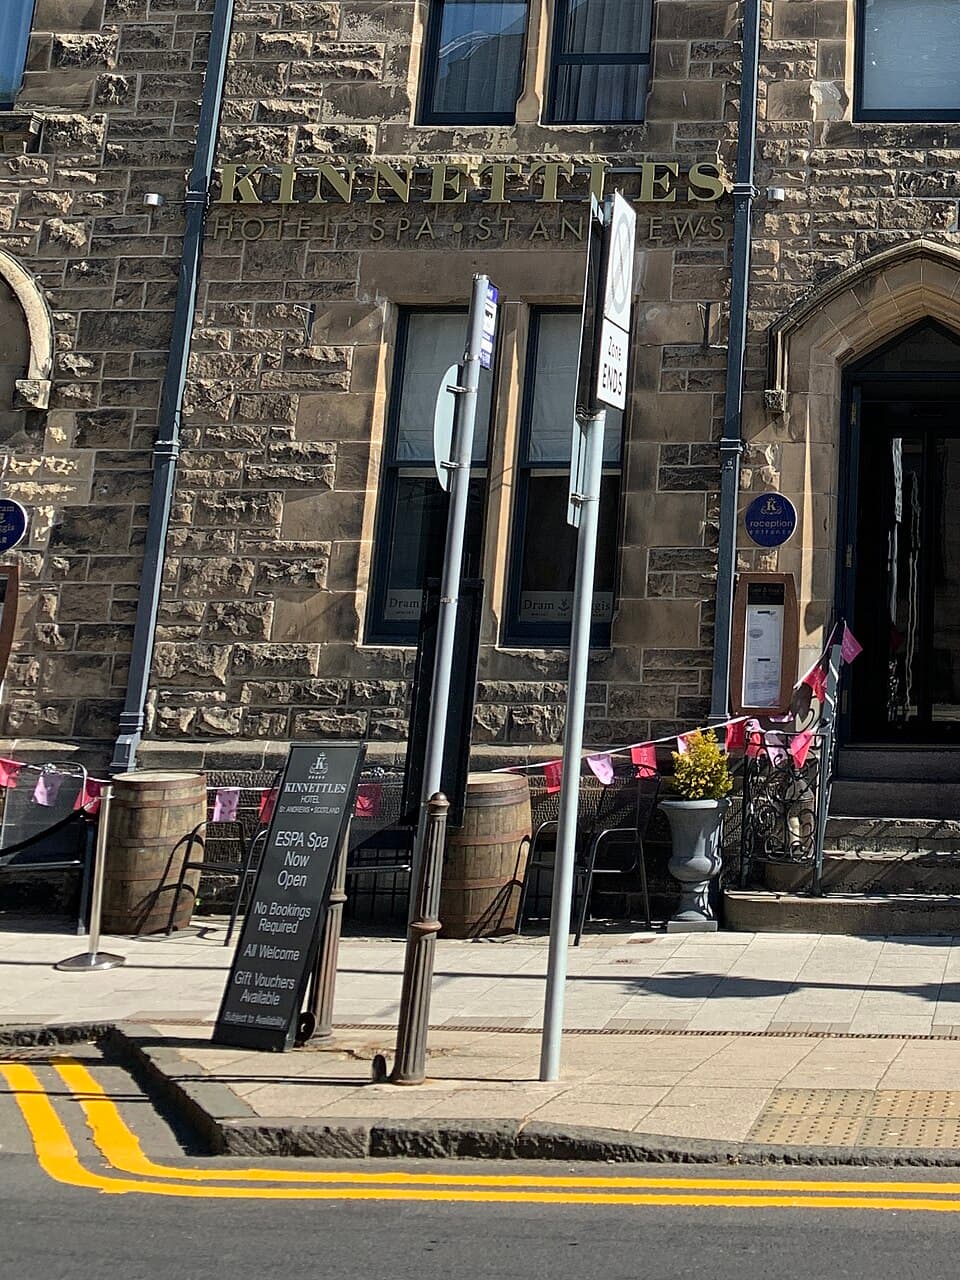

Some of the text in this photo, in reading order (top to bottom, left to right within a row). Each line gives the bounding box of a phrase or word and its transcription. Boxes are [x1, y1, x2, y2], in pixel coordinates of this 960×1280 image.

[212, 162, 725, 204] KINNETTLES
[213, 216, 725, 241] HOTEL SPA ST ANEWS
[608, 335, 621, 361] Zone
[602, 363, 623, 396] ENDS
[750, 520, 793, 528] reception
[390, 598, 418, 608] Dram
[524, 600, 554, 610] Dram
[284, 782, 347, 794] KINNETTLES
[301, 795, 320, 804] HOTEL
[275, 831, 329, 851] ESPA Spa
[284, 851, 310, 867] Now
[277, 870, 307, 890] Open
[254, 901, 311, 920] No Bookings
[258, 918, 299, 935] Required
[243, 943, 300, 960] All Welcome
[234, 971, 296, 990] Gift Vouchers
[240, 989, 280, 1006] Available
